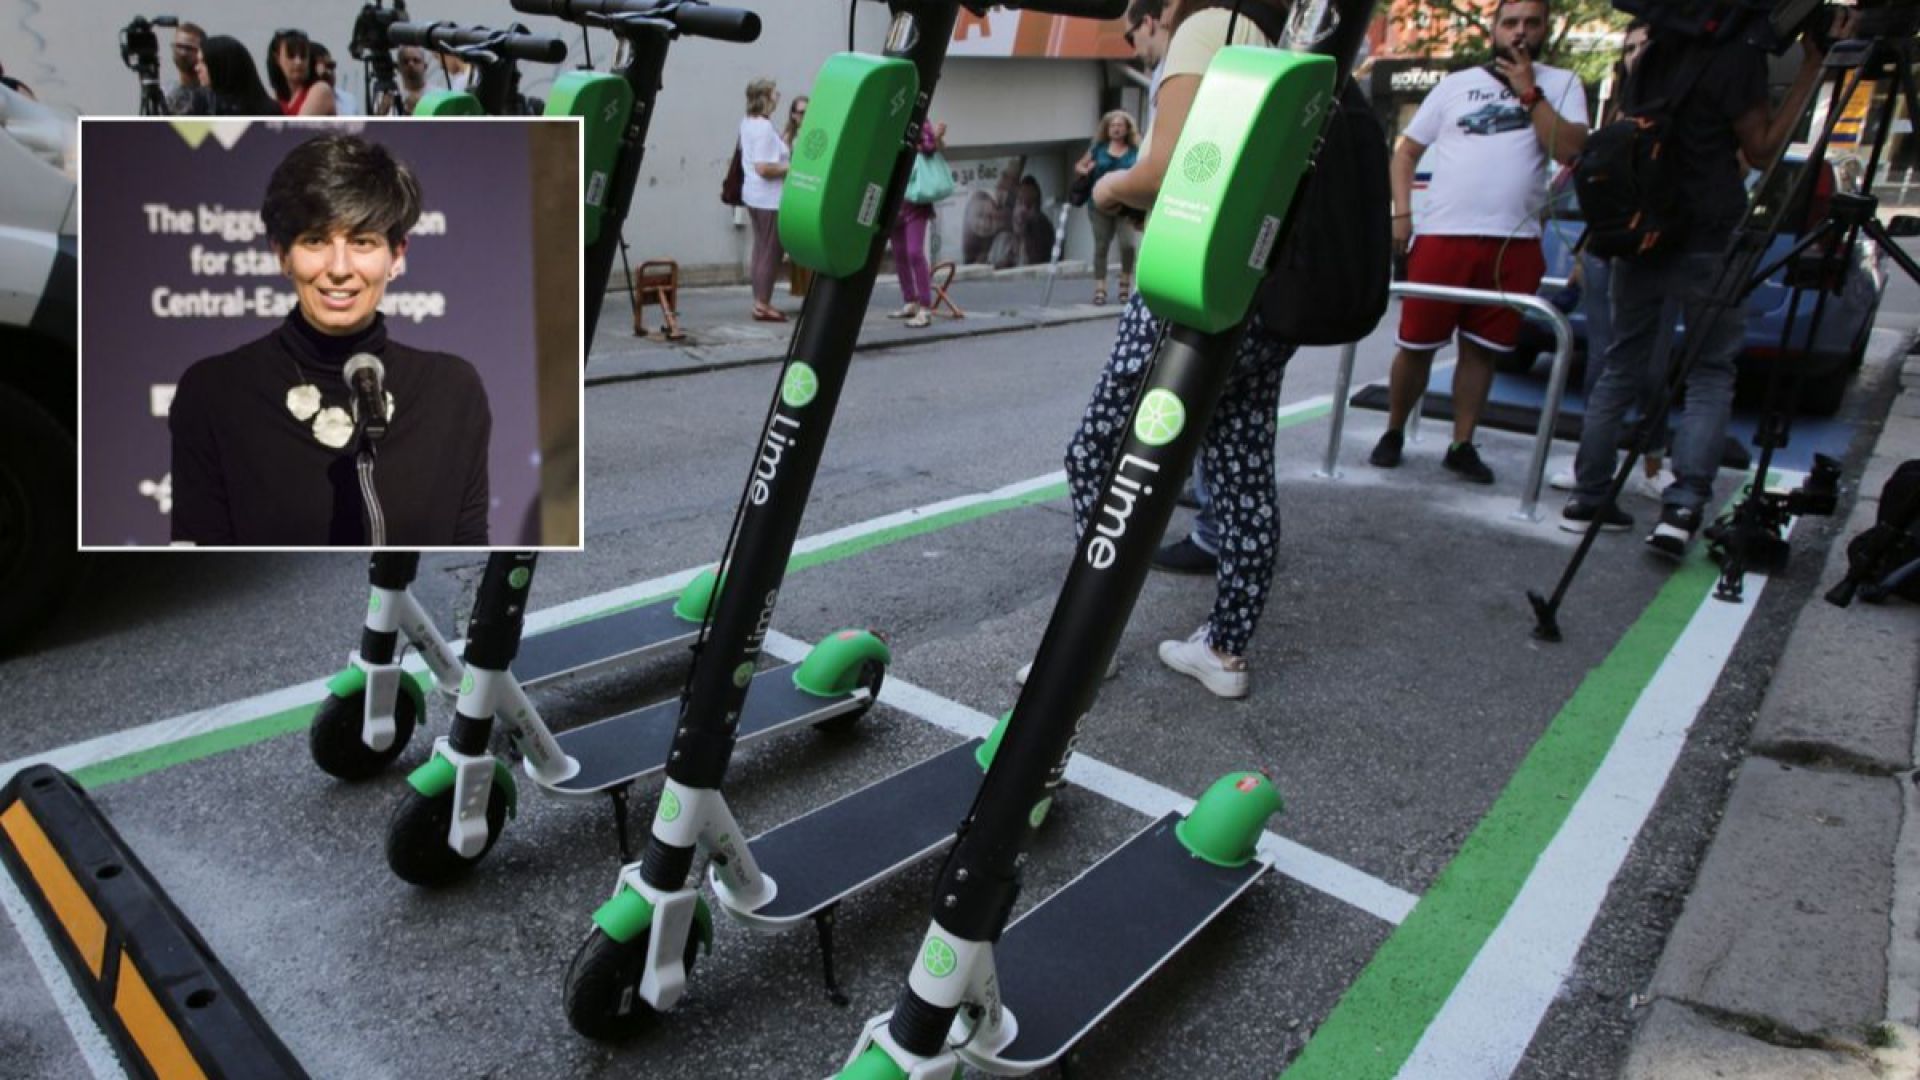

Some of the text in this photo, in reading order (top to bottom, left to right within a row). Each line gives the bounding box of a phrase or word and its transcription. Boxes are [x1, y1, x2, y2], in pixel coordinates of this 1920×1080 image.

[145, 204, 194, 234] The
[190, 244, 282, 275] for sta
[376, 291, 446, 323] urope
[752, 413, 801, 506] Lime
[1087, 453, 1161, 569] Lime
